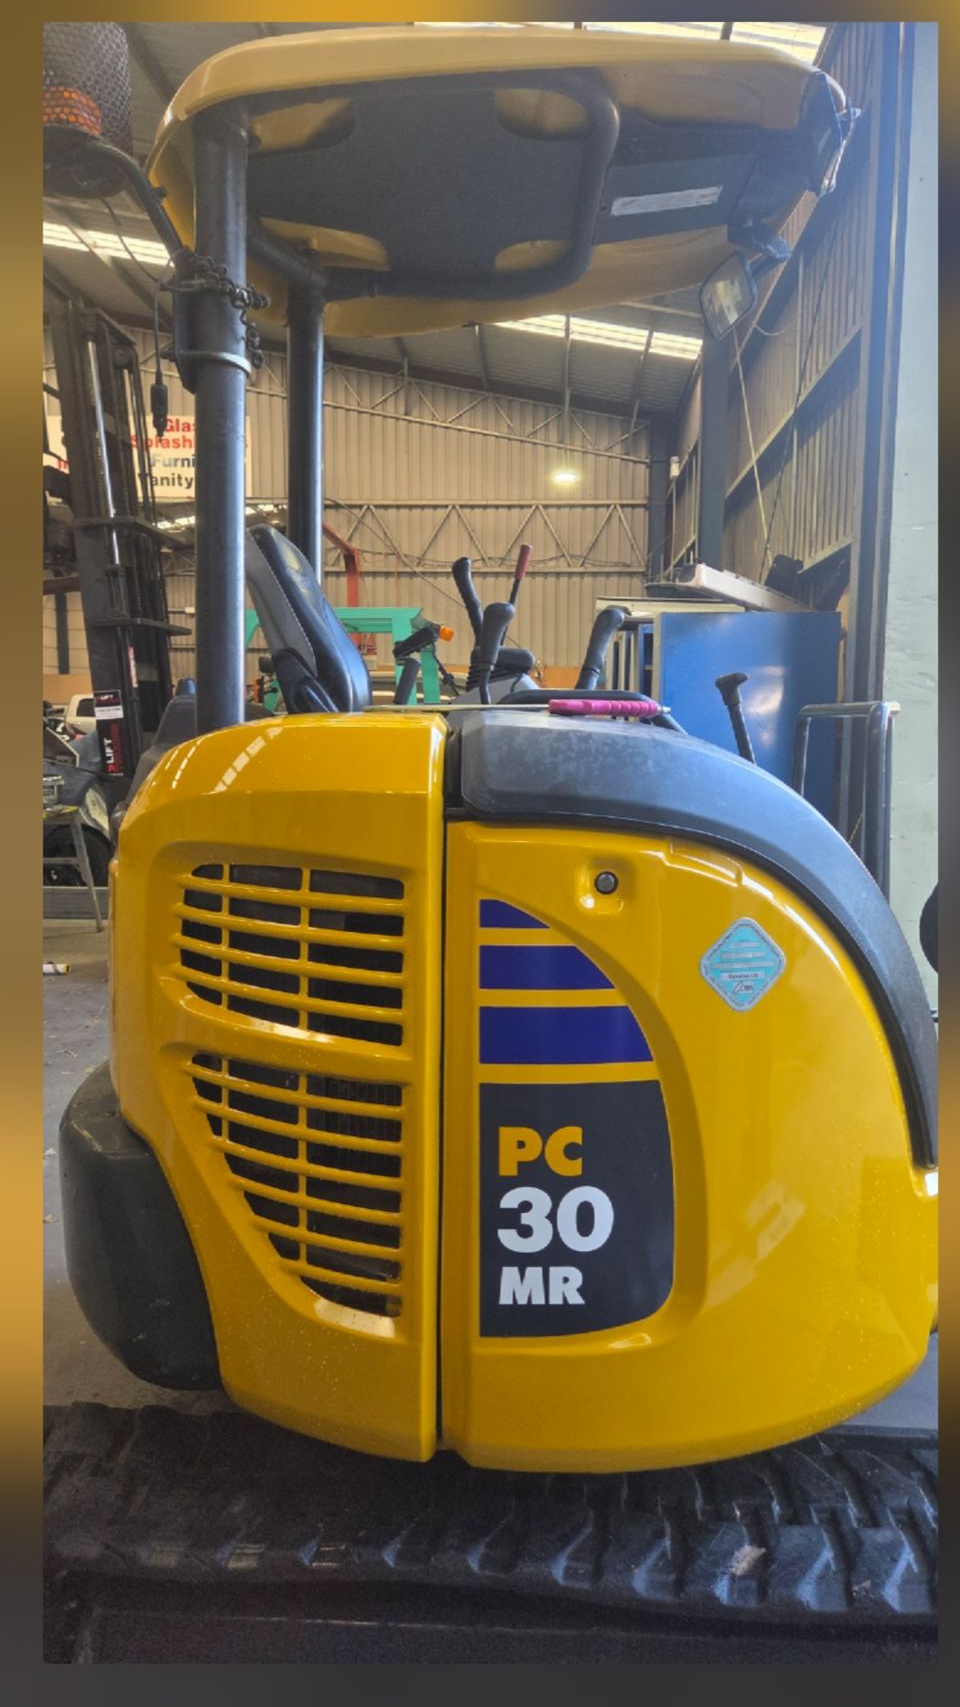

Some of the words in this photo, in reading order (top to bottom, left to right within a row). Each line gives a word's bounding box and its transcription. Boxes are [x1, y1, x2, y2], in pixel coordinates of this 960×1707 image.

[165, 417, 196, 433] Gla
[130, 434, 194, 450] Splash
[151, 452, 196, 468] Furni
[498, 1125, 583, 1177] PC
[497, 1185, 615, 1253] 30
[498, 1266, 586, 1305] MR
